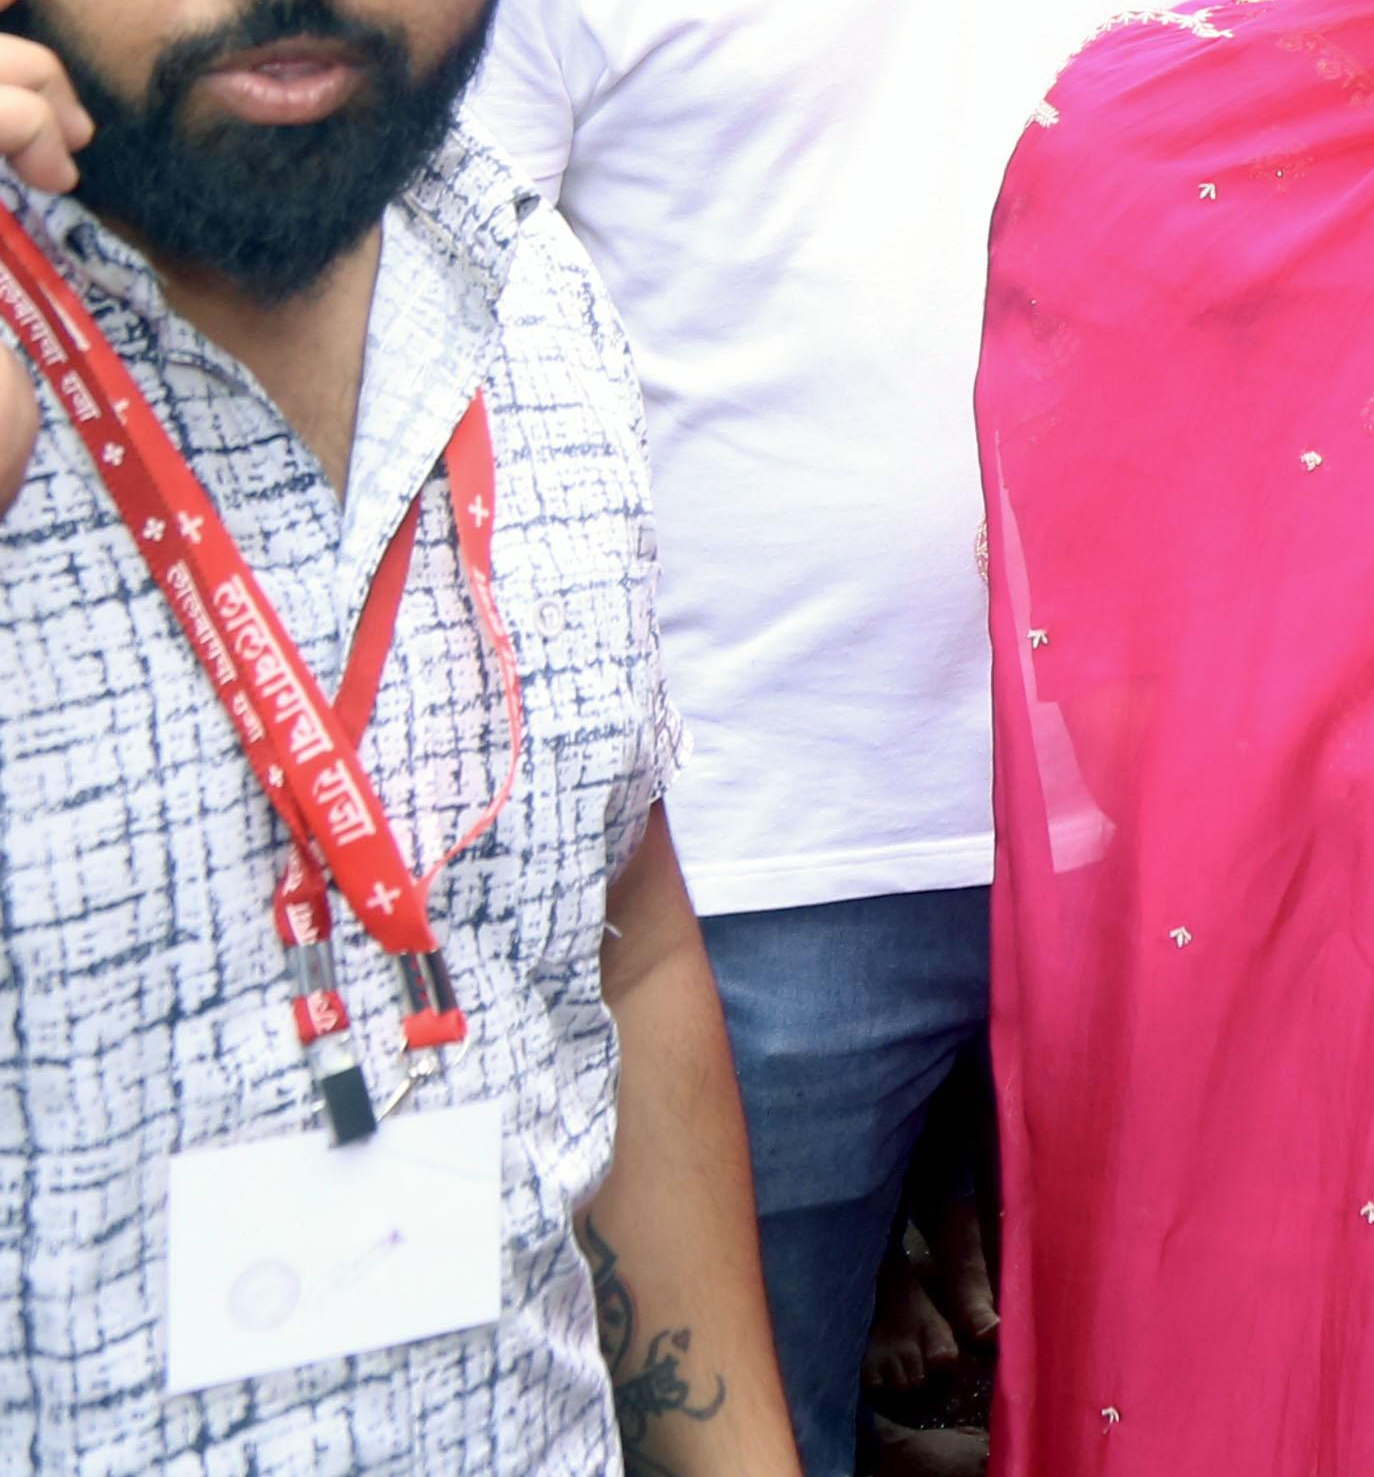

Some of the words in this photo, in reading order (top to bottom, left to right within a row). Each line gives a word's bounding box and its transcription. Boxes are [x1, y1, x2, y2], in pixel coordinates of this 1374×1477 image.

[166, 559, 238, 686] लालबागचा
[212, 573, 334, 765] लालबागचा
[310, 759, 377, 847] राजा
